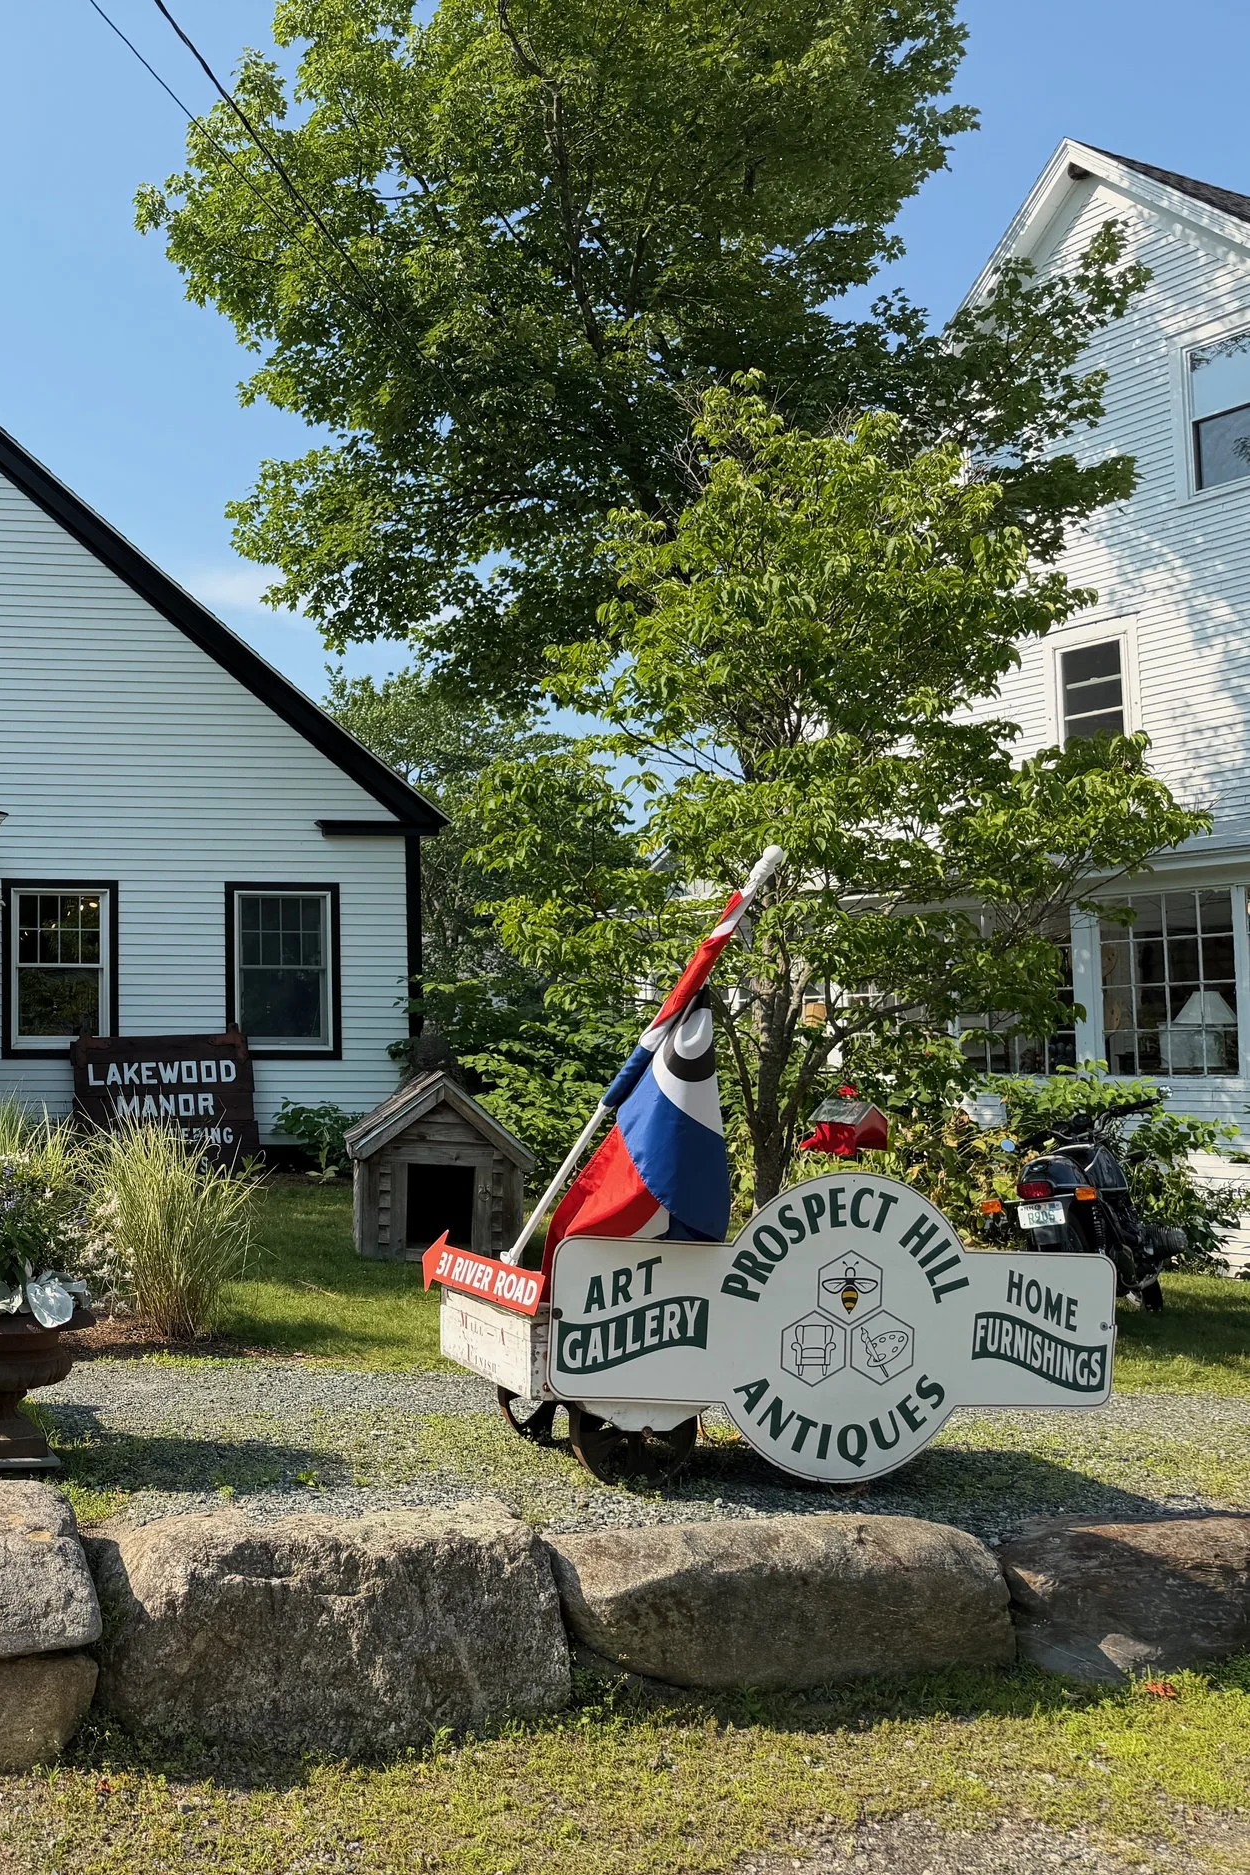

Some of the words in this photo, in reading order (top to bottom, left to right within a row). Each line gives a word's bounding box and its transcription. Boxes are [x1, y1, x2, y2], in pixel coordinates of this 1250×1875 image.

[87, 1059, 237, 1086] LAKEWOOD
[116, 1093, 215, 1117] MANOR
[720, 1186, 899, 1303] PROSPECT
[898, 1212, 970, 1304] HILL
[435, 1251, 454, 1276] 31
[451, 1256, 494, 1292] RIVER
[493, 1270, 538, 1306] ROAD
[583, 1256, 663, 1314] ART
[1006, 1269, 1079, 1332] HOME
[562, 1300, 702, 1369] GALLERY
[974, 1318, 1101, 1386] FURNISHINGS
[733, 1374, 946, 1468] ANTIQUES
